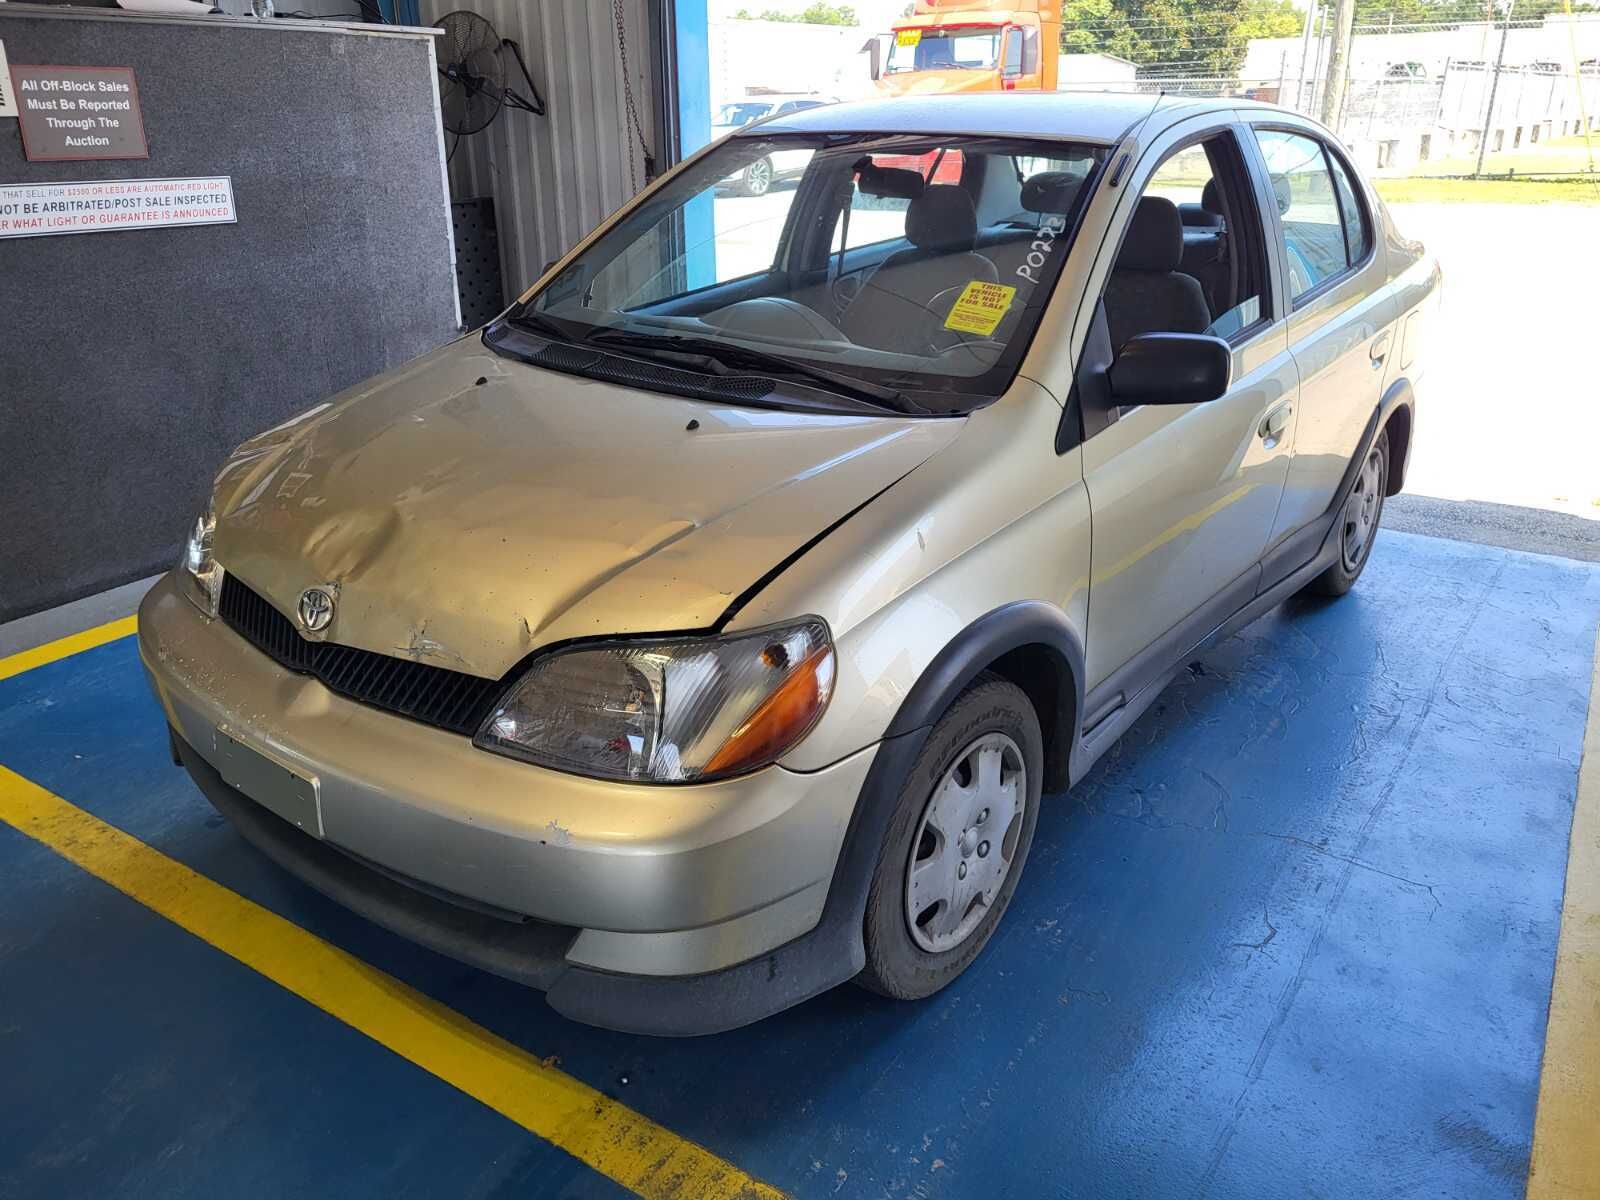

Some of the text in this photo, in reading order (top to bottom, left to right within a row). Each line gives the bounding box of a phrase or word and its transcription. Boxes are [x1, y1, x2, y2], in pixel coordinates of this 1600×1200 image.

[22, 80, 129, 92] All Off-Block Sales
[27, 99, 130, 112] Must Be Reported
[46, 117, 120, 130] Through The
[65, 135, 110, 147] Auction
[127, 185, 142, 194] ARE
[144, 183, 185, 193] AUTOMATIC
[187, 183, 201, 191] RED
[203, 182, 224, 191] LIGHT
[23, 203, 39, 214] BE
[42, 198, 141, 213] ARBITRATED/POST
[145, 196, 171, 208] SALE
[174, 194, 227, 206] INSPECTED
[13, 218, 42, 230] WHAT
[47, 216, 77, 227] LIGHT
[81, 215, 96, 225] OR
[99, 211, 160, 224] GUARANTEE
[162, 210, 170, 220] IS
[172, 207, 229, 219] ANNOUNCED
